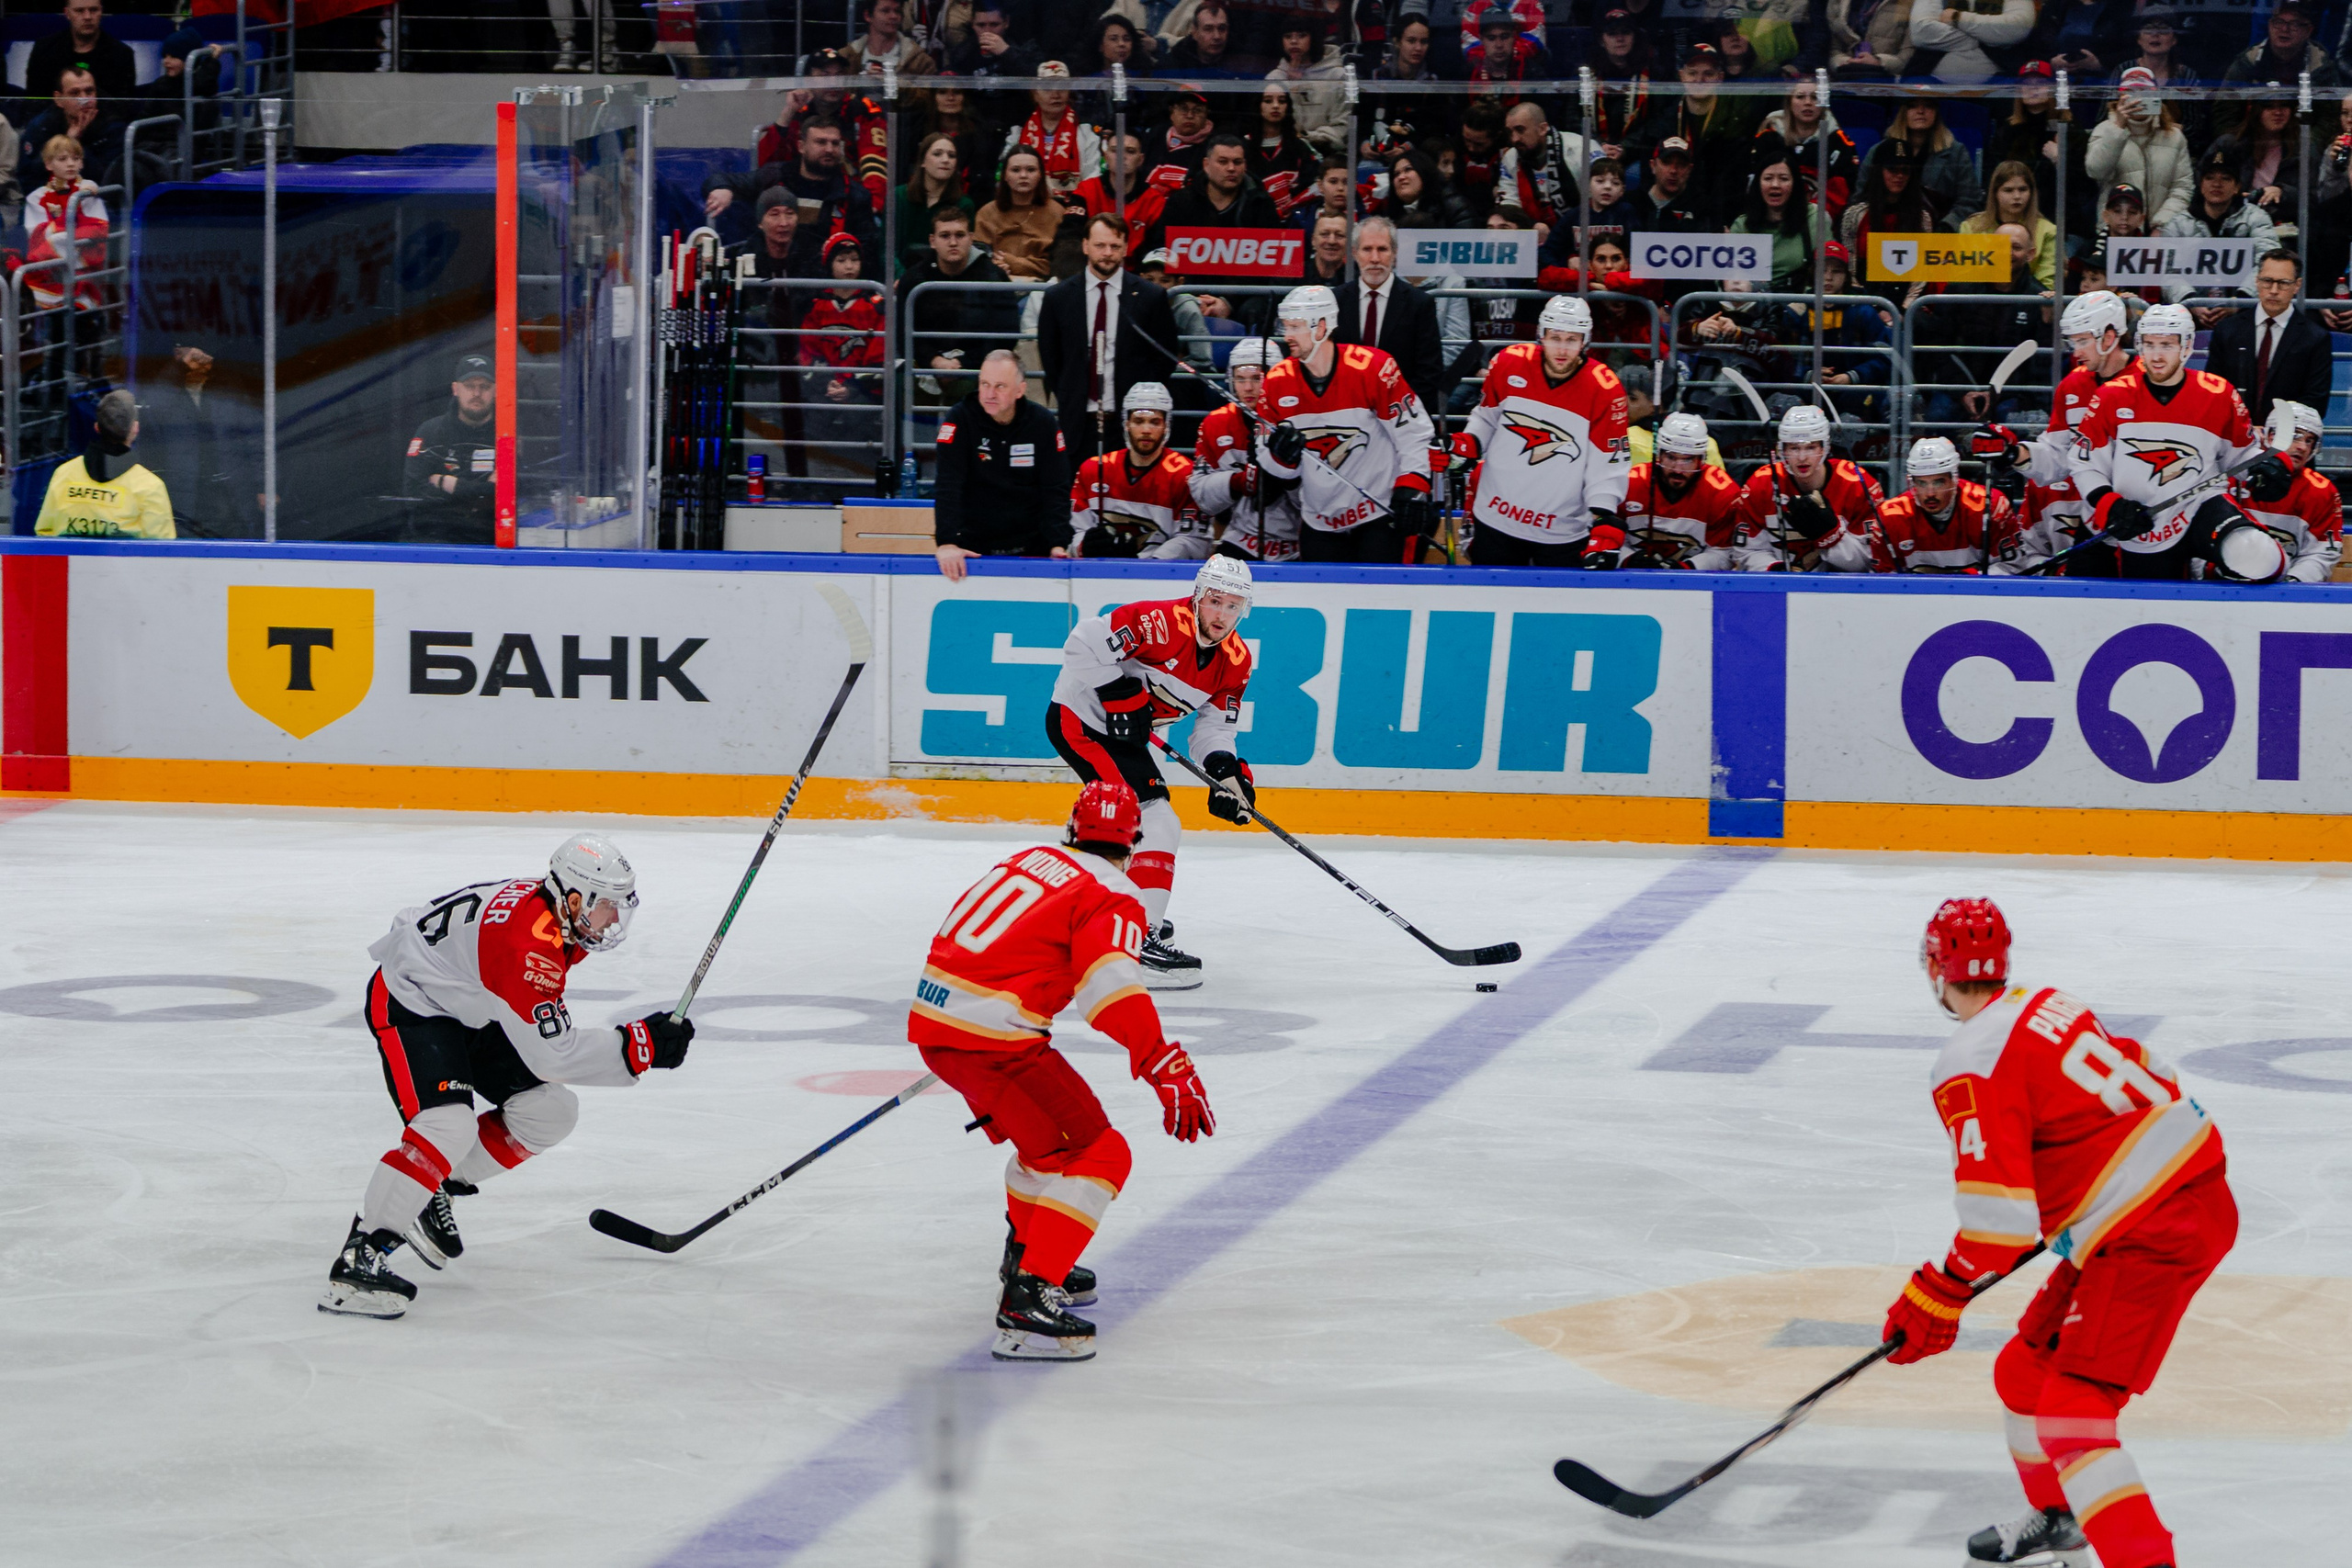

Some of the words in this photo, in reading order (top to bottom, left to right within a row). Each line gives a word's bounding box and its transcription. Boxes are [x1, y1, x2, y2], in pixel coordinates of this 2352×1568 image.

[1171, 237, 1302, 265] FONBET
[1416, 241, 1518, 265] SIBUR
[1924, 250, 1996, 266] БАНК
[2115, 248, 2245, 276] KHL.RU
[68, 487, 119, 502] SAFETY
[1488, 496, 1556, 529] FONBET
[1227, 562, 1242, 575] 51
[409, 630, 710, 704] БАНК
[768, 773, 807, 837] SOYUZ
[1101, 800, 1116, 819] 10
[1016, 850, 1080, 888] WONG
[483, 877, 538, 925] CHER
[938, 866, 1046, 954] 10
[1337, 872, 1411, 930] TRUE
[1112, 913, 1143, 958] 10
[695, 935, 720, 978] SOYUZ
[1968, 958, 1996, 977] 84
[729, 1172, 784, 1216] CCM
